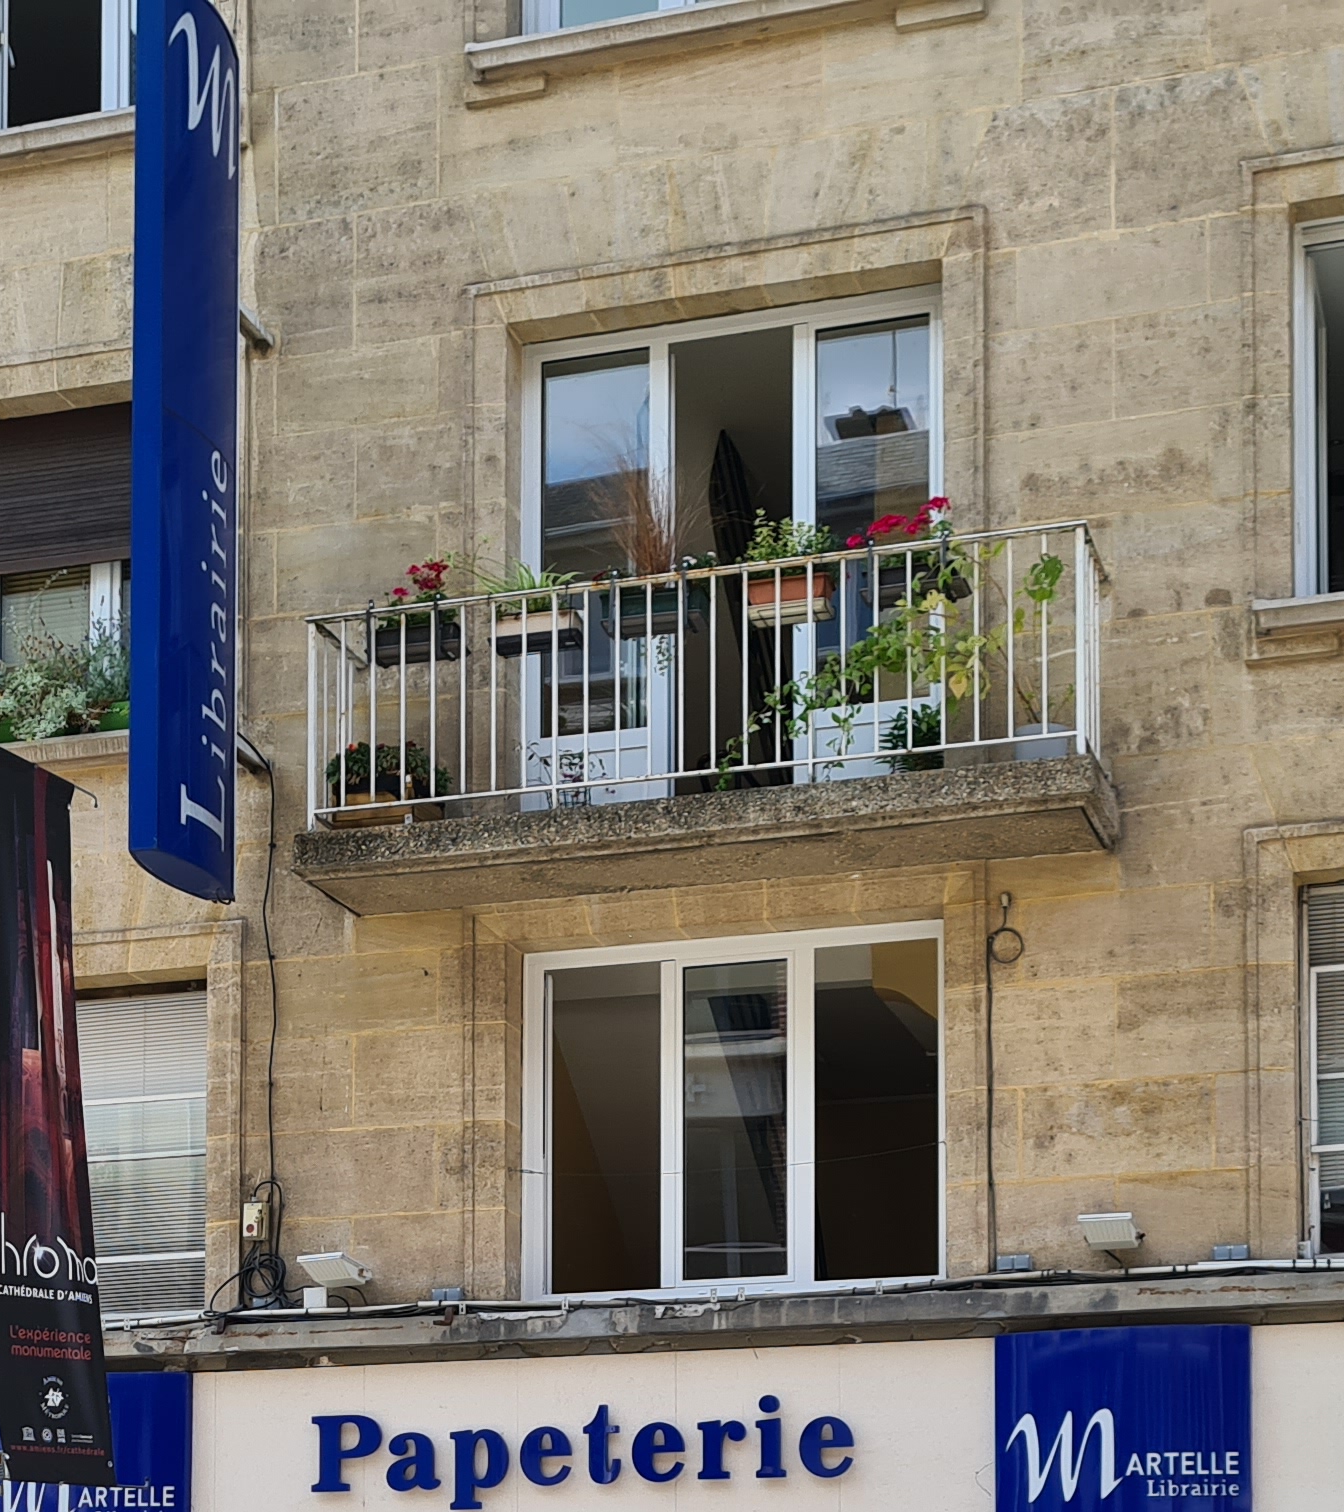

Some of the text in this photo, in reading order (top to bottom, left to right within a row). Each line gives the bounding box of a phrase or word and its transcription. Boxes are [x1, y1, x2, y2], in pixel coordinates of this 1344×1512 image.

[180, 449, 229, 852] Librairie
[57, 1290, 93, 1304] D'AMIENS
[9, 1325, 91, 1344] L'expérience
[11, 1344, 92, 1361] monumentale
[311, 1394, 855, 1510] Papeterie
[1147, 1479, 1240, 1497] Librairie
